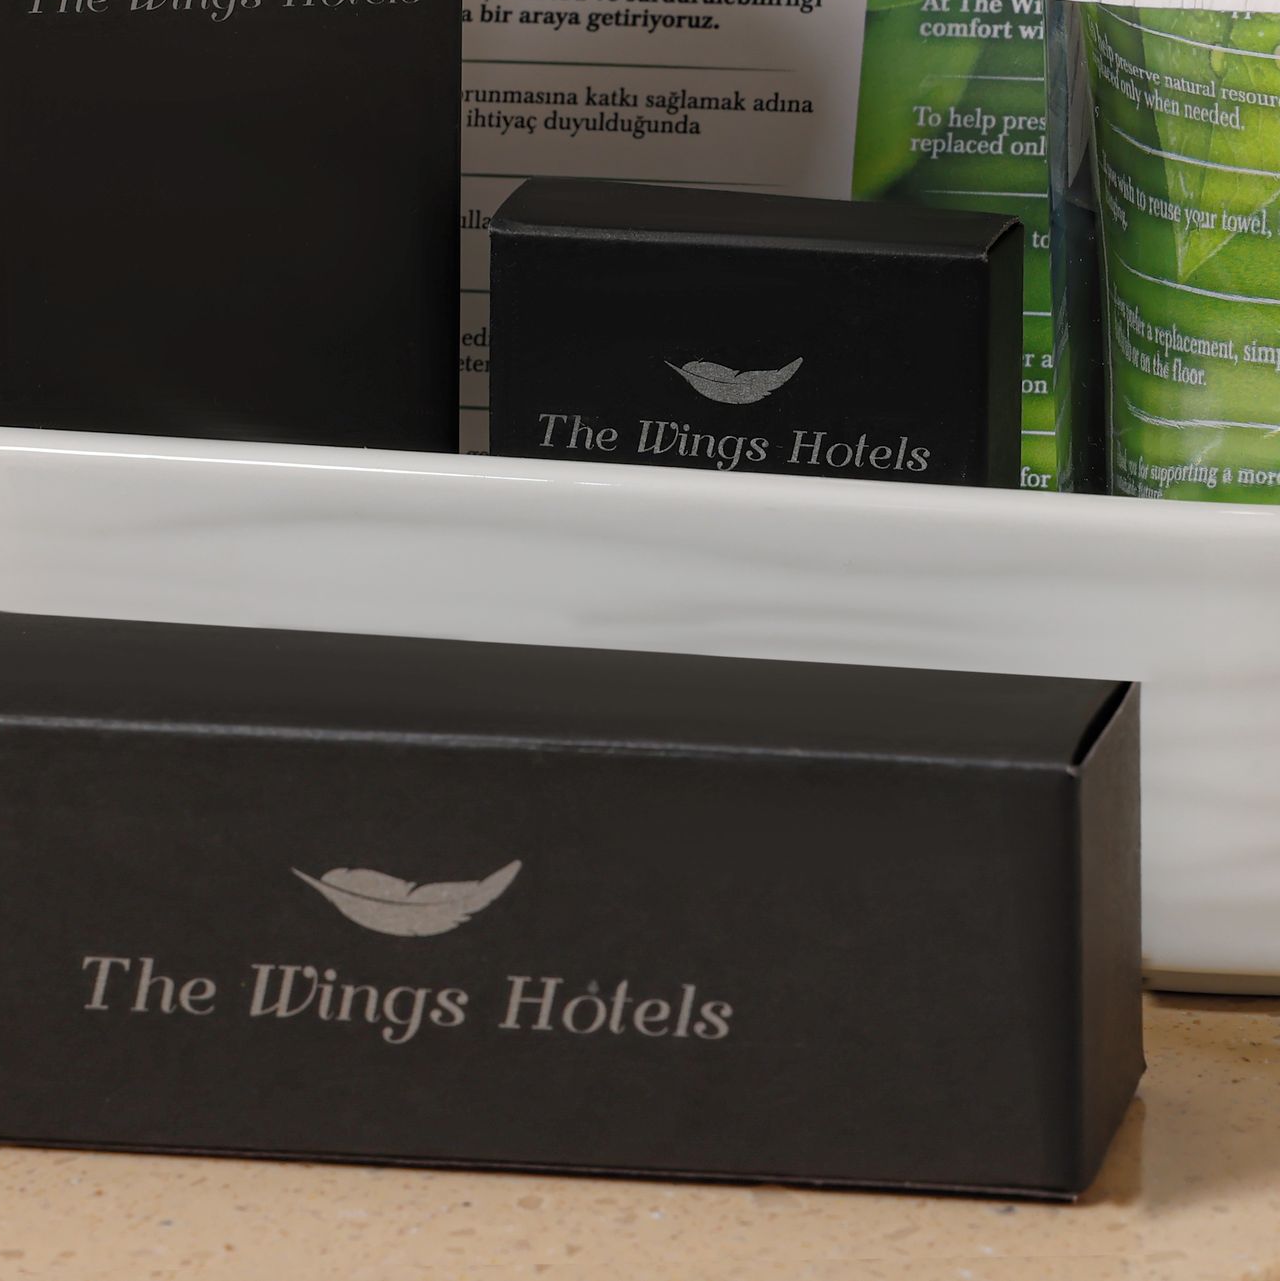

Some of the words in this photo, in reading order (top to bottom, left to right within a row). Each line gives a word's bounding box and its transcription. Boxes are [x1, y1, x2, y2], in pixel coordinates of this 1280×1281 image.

[480, 4, 513, 23] bir
[519, 10, 580, 30] araya
[587, 7, 720, 33] getiriyoruz.
[920, 18, 1013, 39] comfort
[461, 89, 578, 106] runmasına
[586, 86, 639, 108] katkı
[645, 89, 746, 114] sağlamak
[753, 91, 814, 114] adına
[1164, 76, 1216, 98] natural
[1121, 78, 1142, 110] only
[1144, 88, 1180, 116] when
[1184, 103, 1246, 130] needed.
[466, 108, 538, 135] ihtiyaç
[544, 110, 701, 139] duyulduğunda
[913, 106, 942, 127] To
[948, 106, 996, 135] help
[910, 132, 1004, 159] replaced
[1149, 196, 1181, 223] reuse
[1184, 208, 1217, 231] your
[1222, 210, 1272, 237] towel,
[1154, 323, 1239, 366] replacement,
[1041, 353, 1054, 368] a
[1173, 357, 1207, 386] floor.
[538, 412, 619, 452] The
[637, 420, 769, 471] Wings
[786, 429, 931, 472] Hotels
[1021, 466, 1052, 488] for
[1151, 463, 1219, 489] supporting
[1223, 467, 1233, 483] a
[80, 956, 216, 1016] The
[248, 962, 470, 1044] Wings
[498, 974, 735, 1040] Hotels
